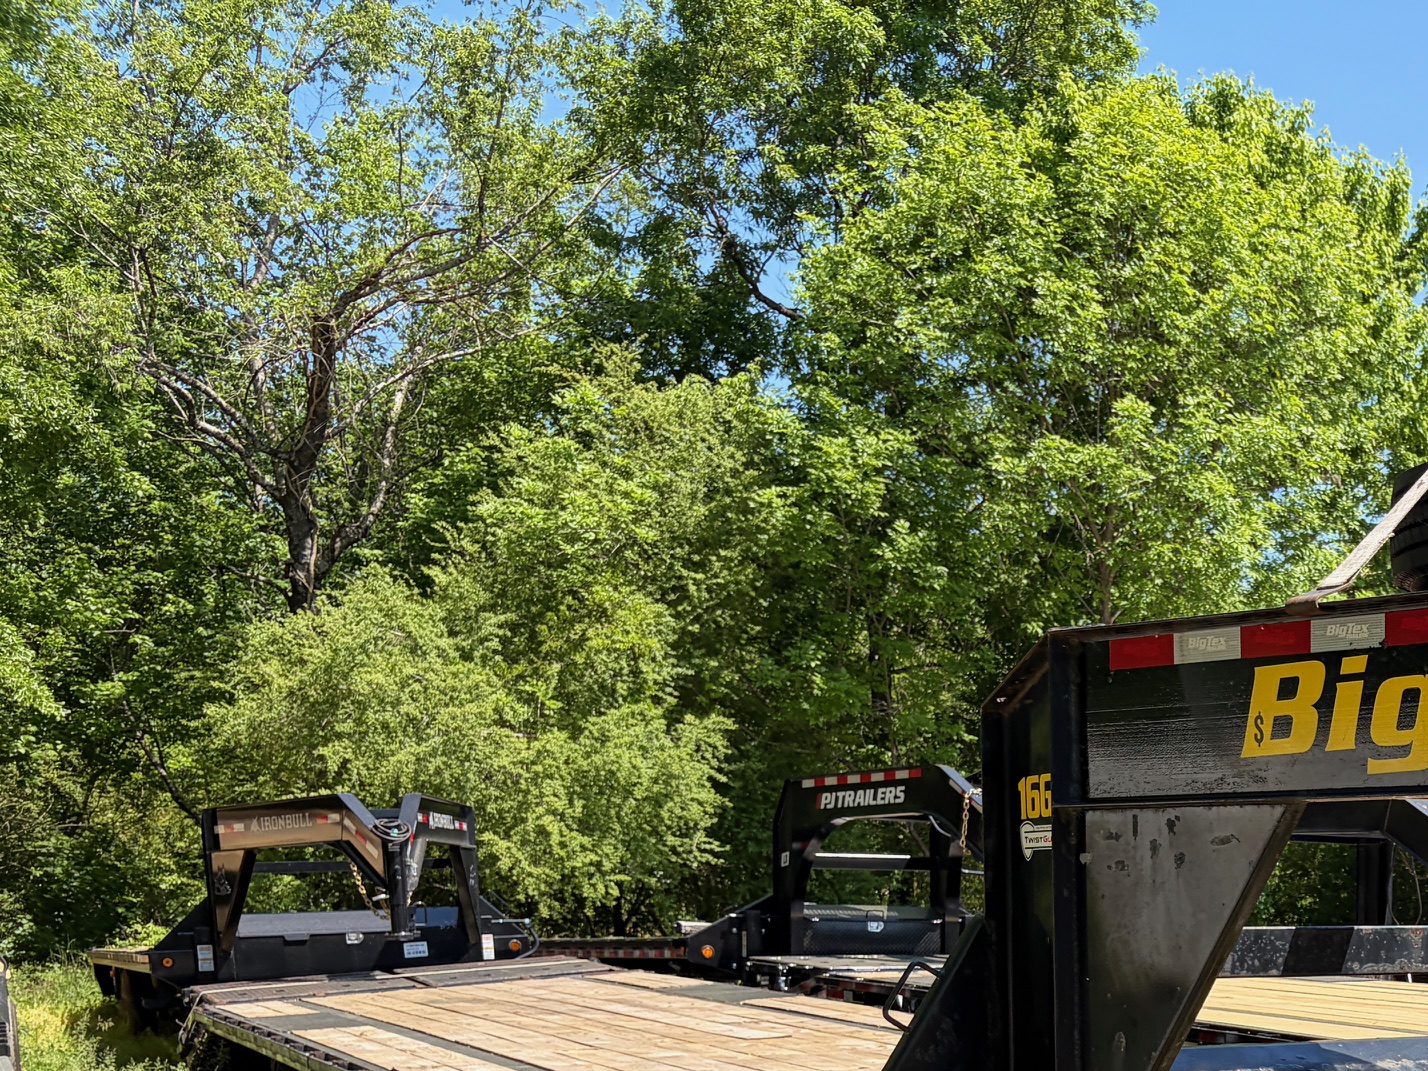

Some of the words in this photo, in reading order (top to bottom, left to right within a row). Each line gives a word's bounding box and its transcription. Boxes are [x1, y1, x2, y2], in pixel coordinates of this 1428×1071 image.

[1327, 623, 1369, 638] BigTex
[1188, 636, 1227, 650] BigTex
[260, 812, 313, 831] IRONBULL
